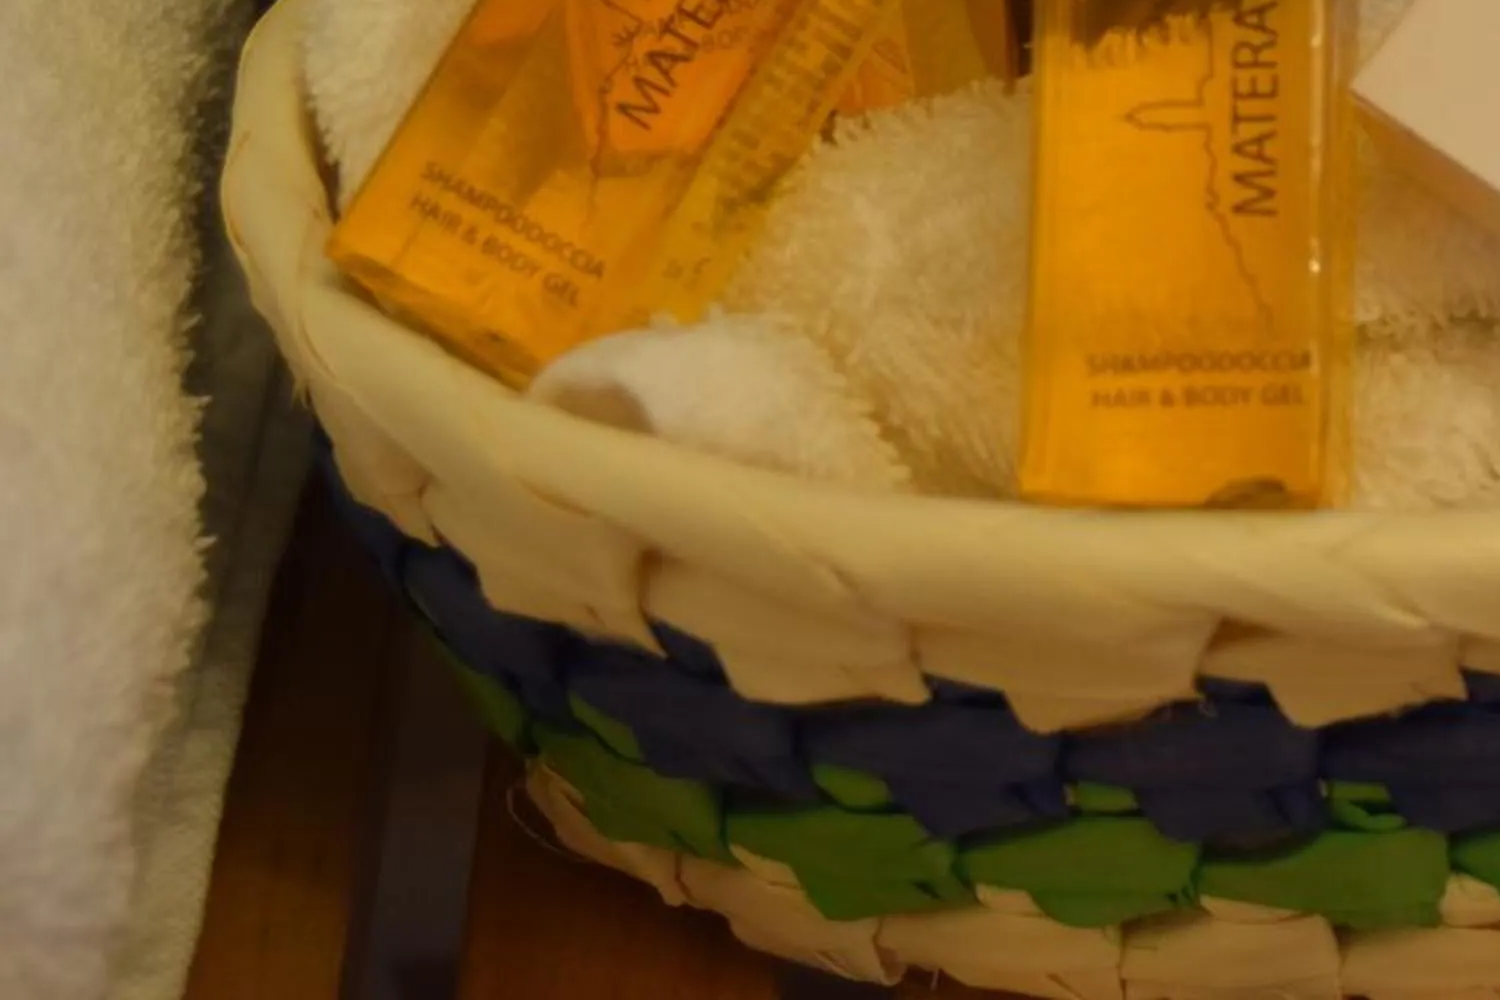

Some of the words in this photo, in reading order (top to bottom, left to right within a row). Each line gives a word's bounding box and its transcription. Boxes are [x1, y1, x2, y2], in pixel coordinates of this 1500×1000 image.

[409, 192, 463, 235] HAIR
[481, 234, 543, 278] BODY
[543, 273, 580, 307] GEL
[1091, 388, 1151, 407] HAIR
[1184, 386, 1252, 407] BODY
[1260, 383, 1304, 406] GEL
